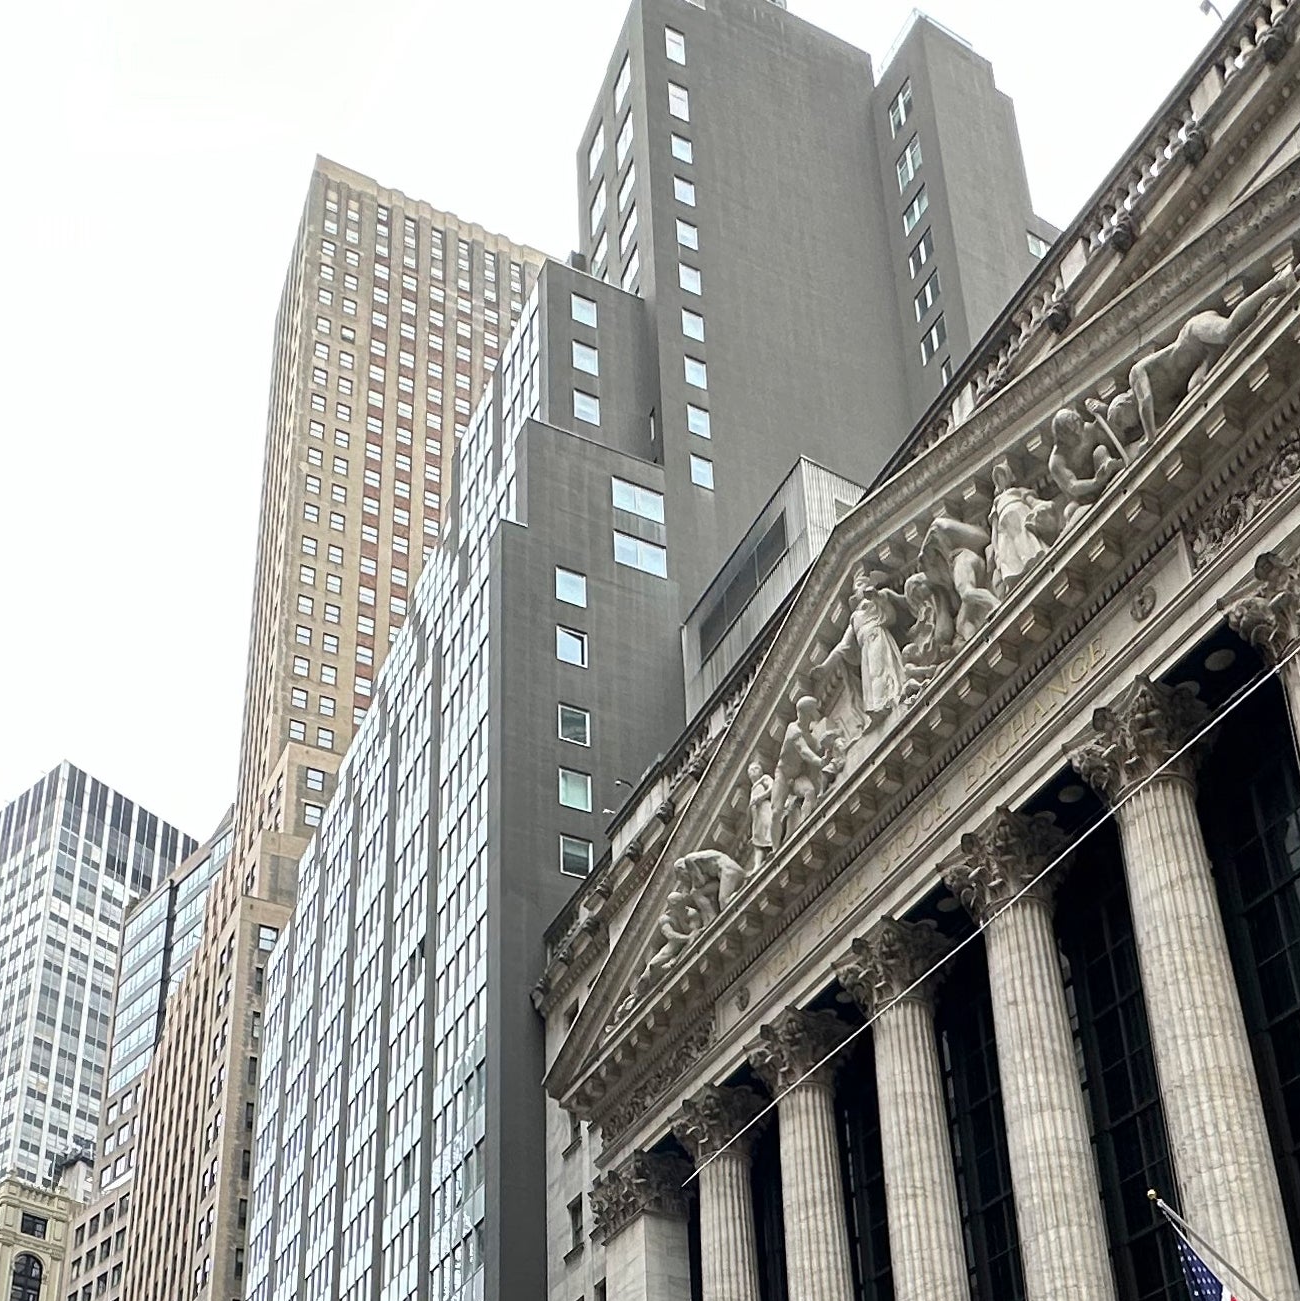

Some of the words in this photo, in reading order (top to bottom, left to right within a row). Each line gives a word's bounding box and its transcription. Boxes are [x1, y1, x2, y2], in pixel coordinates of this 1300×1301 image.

[762, 930, 803, 987] NEW
[812, 870, 868, 937] YORK
[881, 788, 950, 873] STOCK
[963, 637, 1107, 793] EXCHANGE
